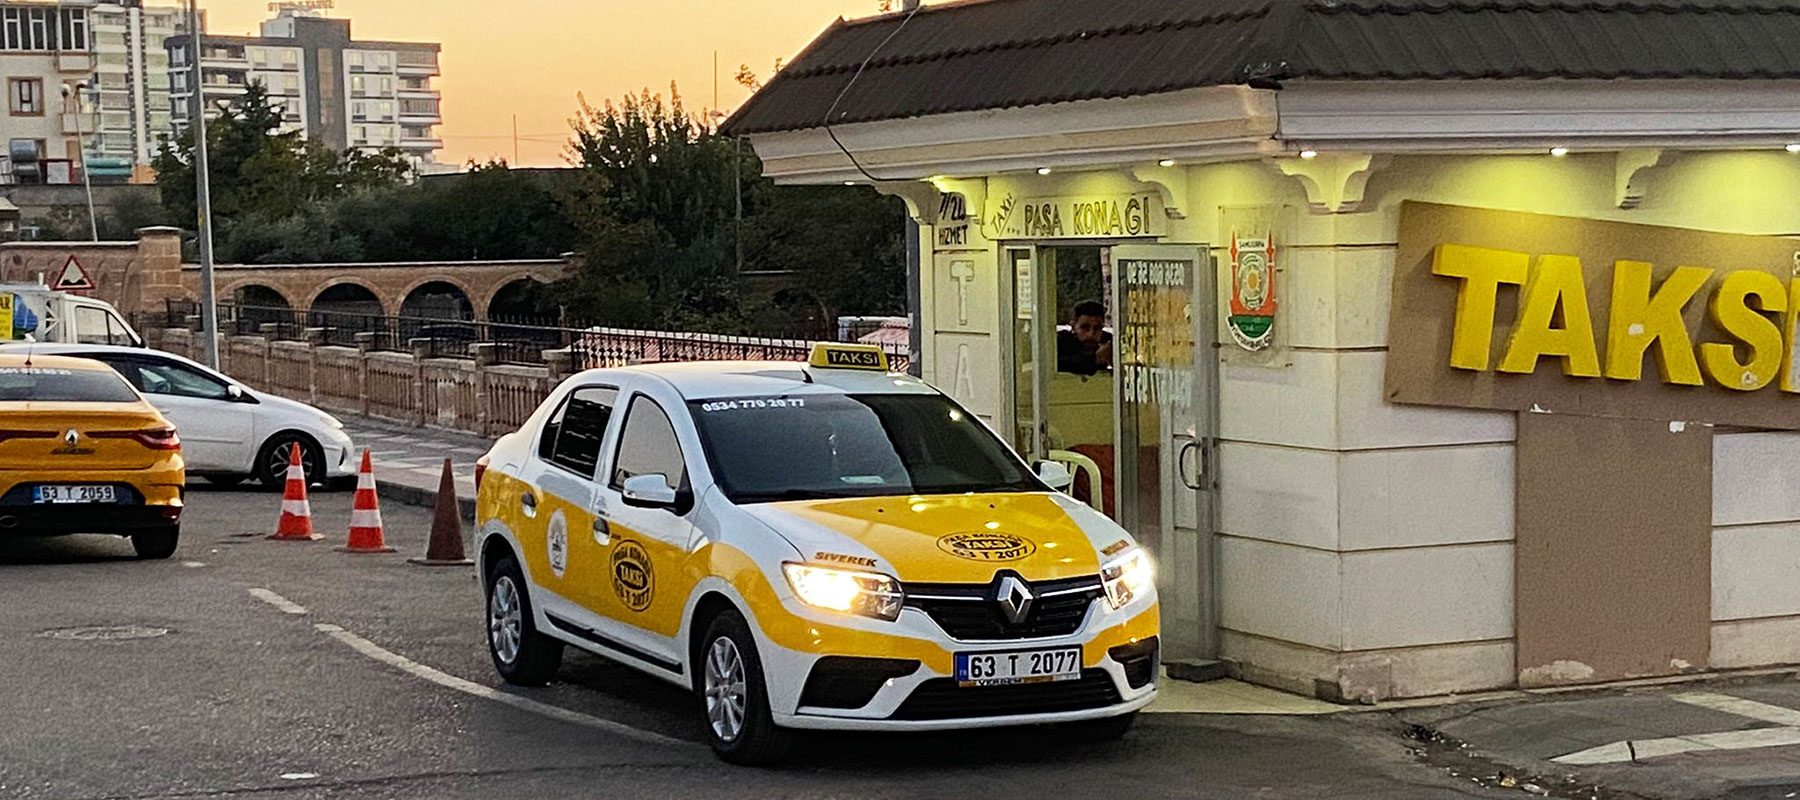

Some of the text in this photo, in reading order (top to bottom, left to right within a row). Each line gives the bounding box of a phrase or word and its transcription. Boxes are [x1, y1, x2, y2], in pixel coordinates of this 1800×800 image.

[1073, 193, 1149, 236] KONAĞI
[701, 398, 805, 412] 0534 770 20 77
[41, 486, 112, 499] 63 T 2059
[981, 551, 990, 559] T
[996, 546, 1028, 559] 2077
[970, 655, 996, 678] 63
[1008, 654, 1019, 676] T
[1030, 650, 1077, 675] 2077
